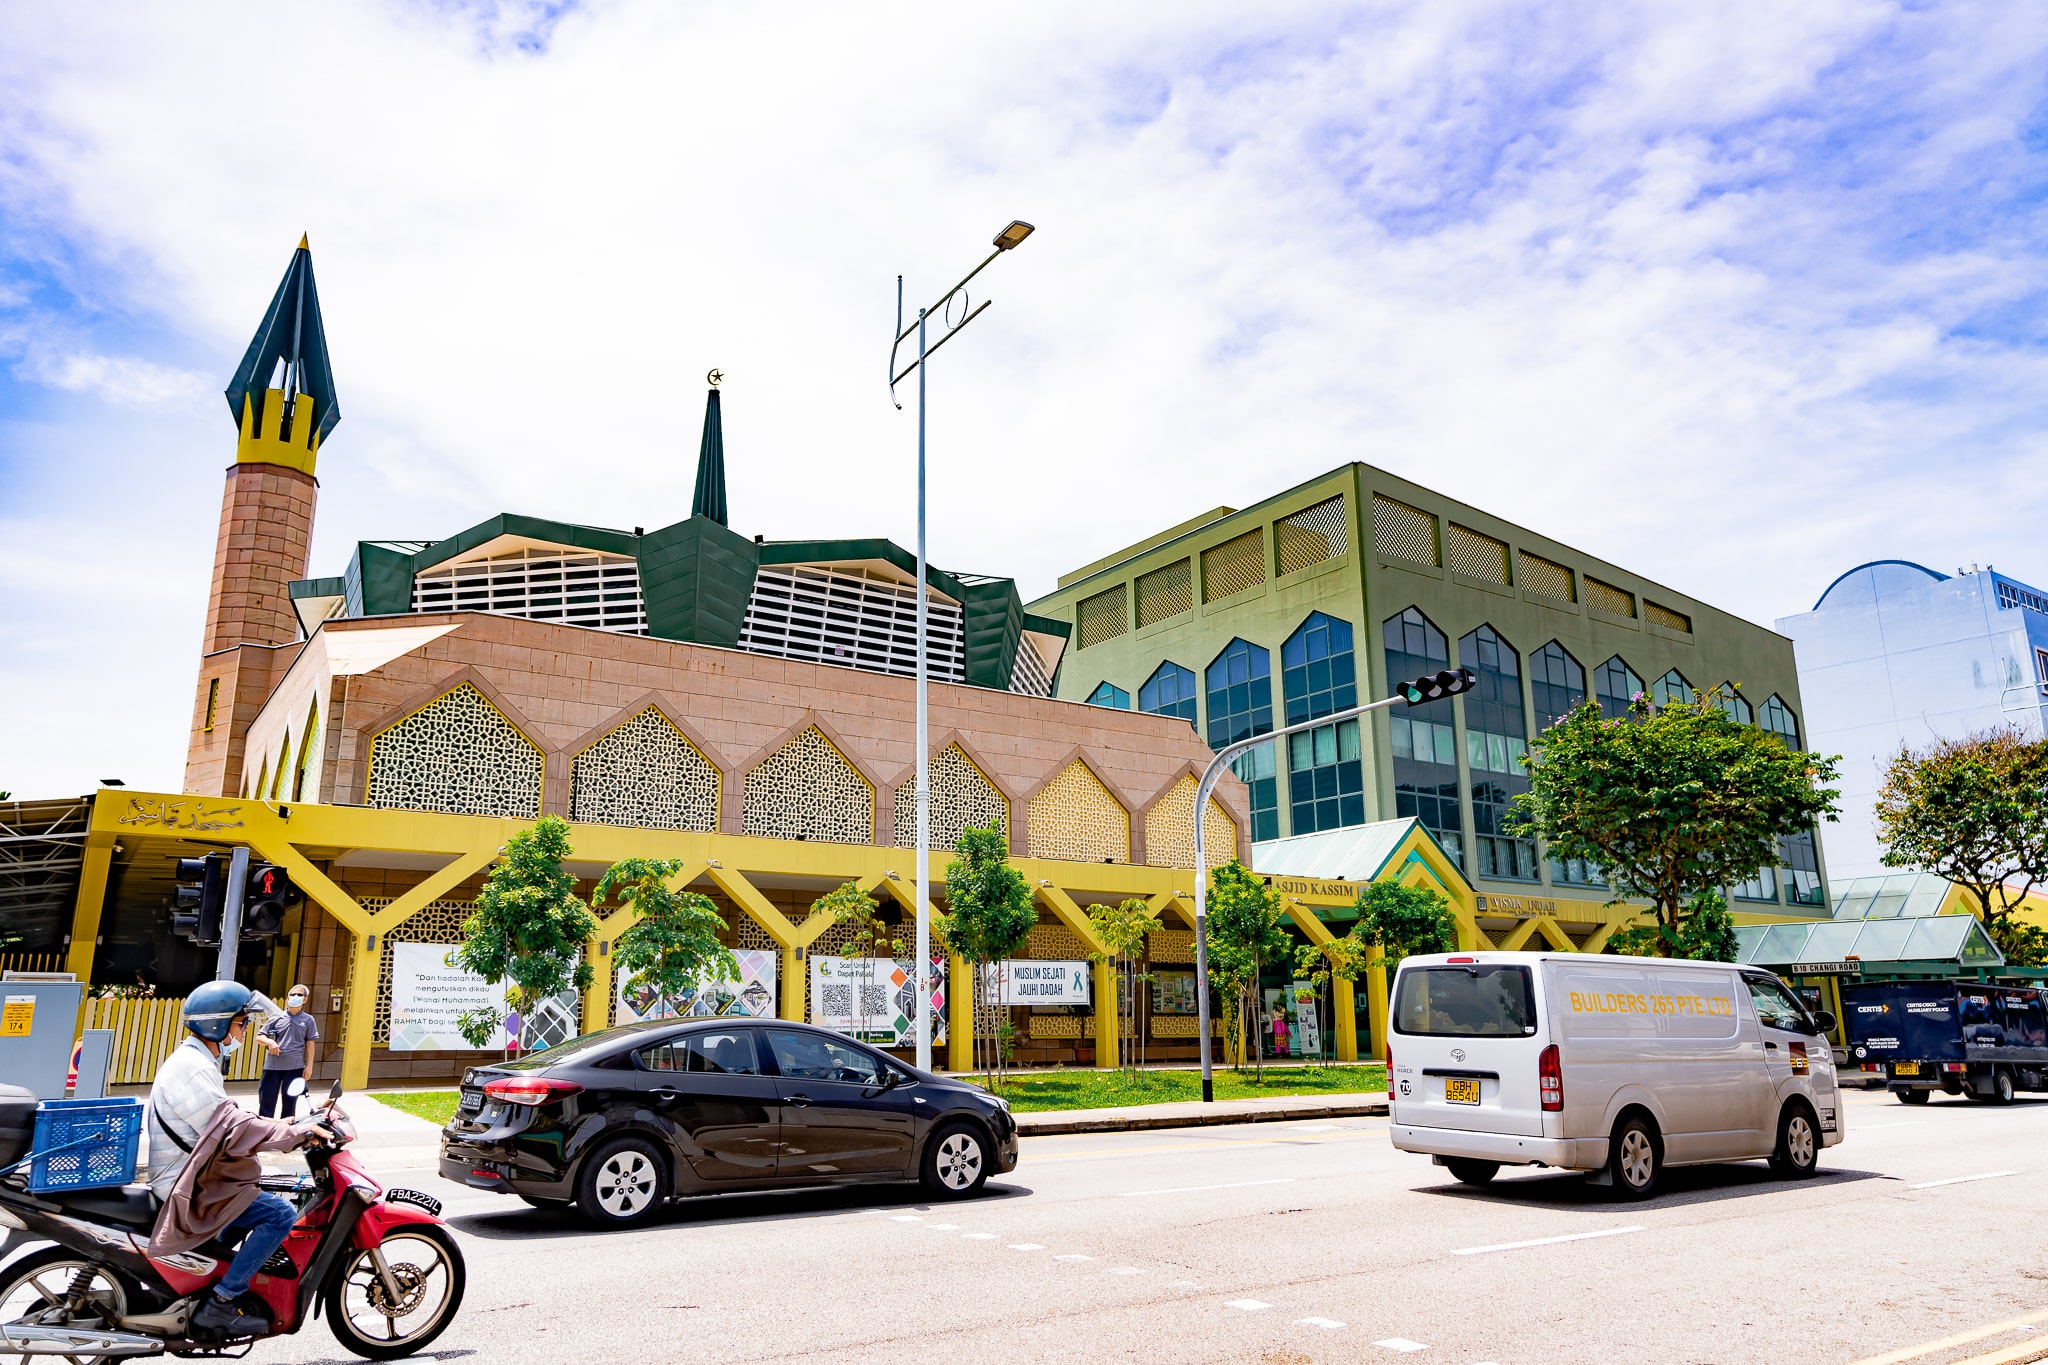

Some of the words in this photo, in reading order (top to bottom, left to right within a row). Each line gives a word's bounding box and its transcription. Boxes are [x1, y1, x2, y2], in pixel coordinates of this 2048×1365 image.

[1311, 883, 1353, 897] KASSIM
[1490, 897, 1522, 909] WISMA
[1528, 900, 1557, 911] INDAH
[1014, 967, 1041, 980] MUSLIM
[1043, 968, 1066, 980] SEJATI
[1809, 963, 1837, 972] CHANGI
[1839, 963, 1859, 971] ROAD
[1018, 984, 1039, 996] JAUHI
[1040, 984, 1063, 996] DADAH
[1569, 992, 1648, 1013] BUILDERS
[1650, 994, 1675, 1014] 265
[1676, 995, 1705, 1014] PTE
[1706, 996, 1731, 1015] LTD
[428, 1018, 446, 1026] bagi
[1401, 1082, 1411, 1090] 70
[1453, 1080, 1472, 1091] GBH
[1446, 1090, 1479, 1102] 8654U
[390, 1189, 439, 1212] FBA2221L
